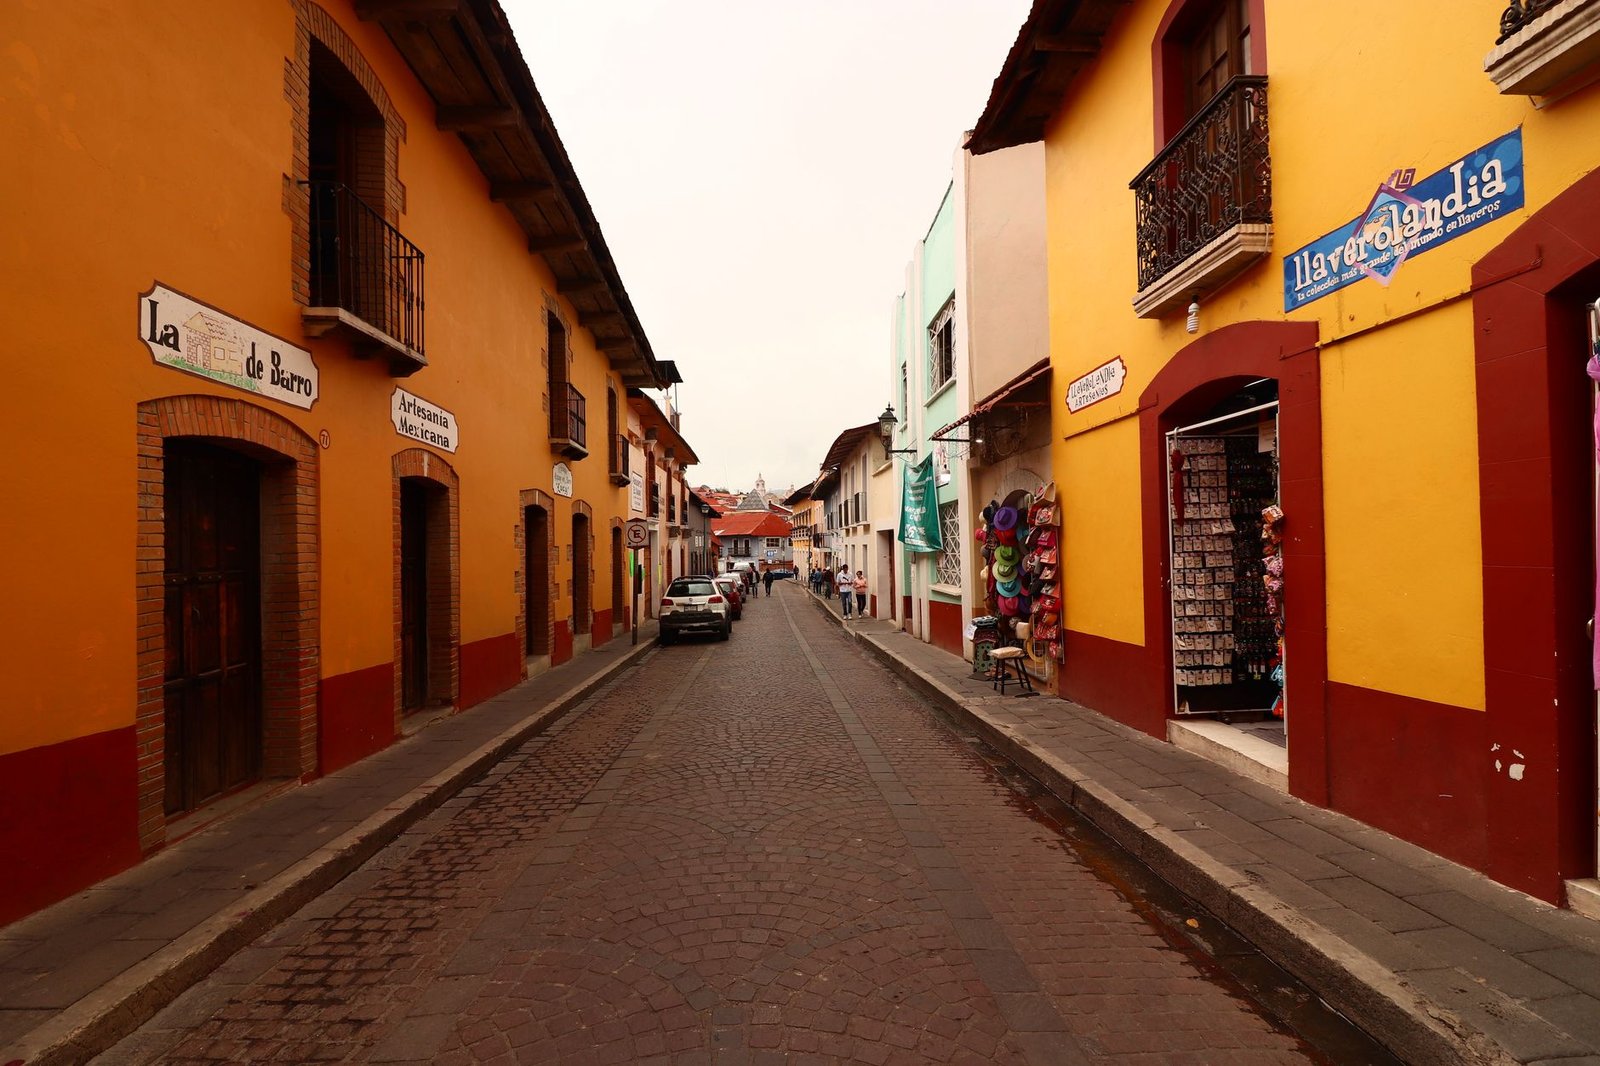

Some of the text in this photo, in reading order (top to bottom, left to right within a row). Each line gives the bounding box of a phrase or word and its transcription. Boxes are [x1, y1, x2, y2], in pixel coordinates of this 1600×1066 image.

[1293, 158, 1506, 291] llaverolandia
[1359, 251, 1391, 275] grande
[1393, 242, 1409, 257] del
[1410, 227, 1443, 250] mundo
[1446, 220, 1457, 233] en
[1458, 200, 1501, 226] llaveros
[147, 298, 312, 398] La de Barro
[398, 415, 450, 449] Mexicana
[633, 529, 641, 539] E
